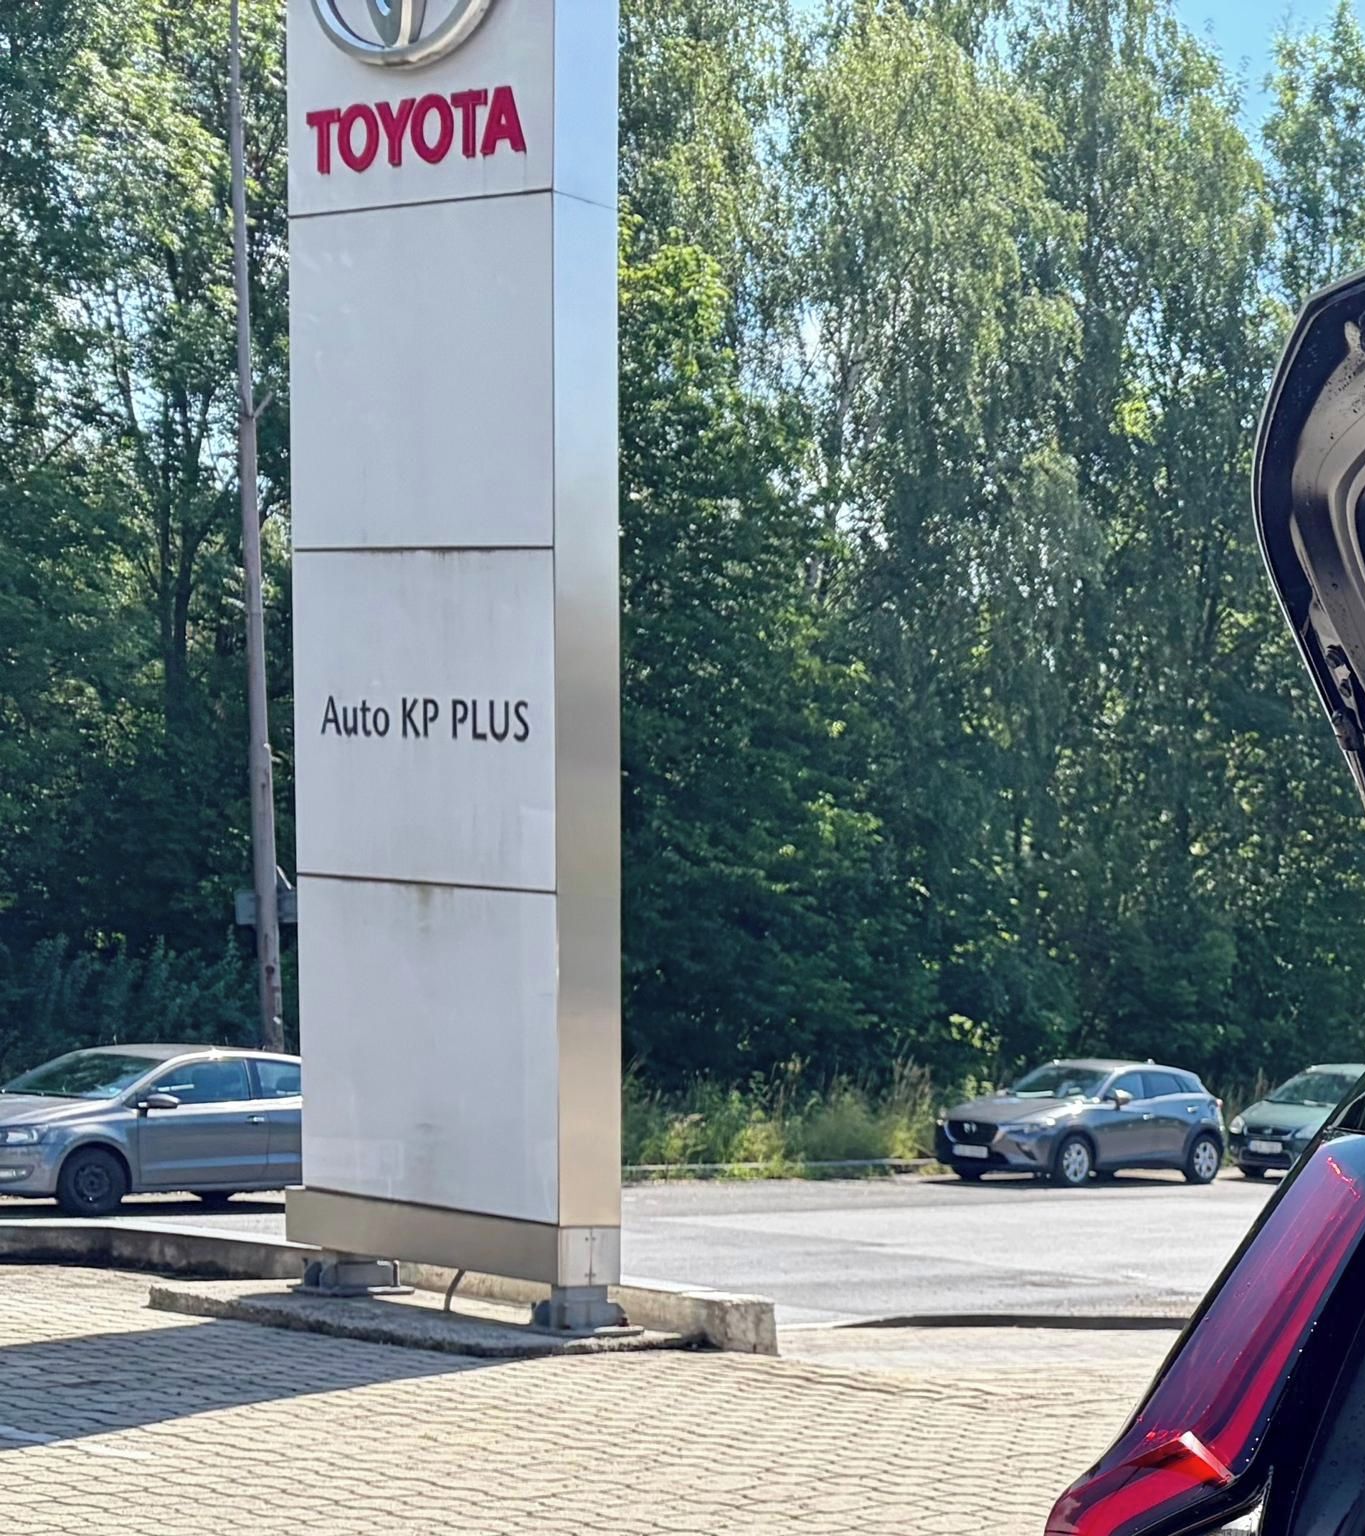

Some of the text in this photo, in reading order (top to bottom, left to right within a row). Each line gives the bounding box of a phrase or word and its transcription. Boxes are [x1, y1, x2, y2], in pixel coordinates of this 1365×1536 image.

[306, 86, 527, 175] TOYOTA
[321, 695, 530, 742] Auto KP PLUS
